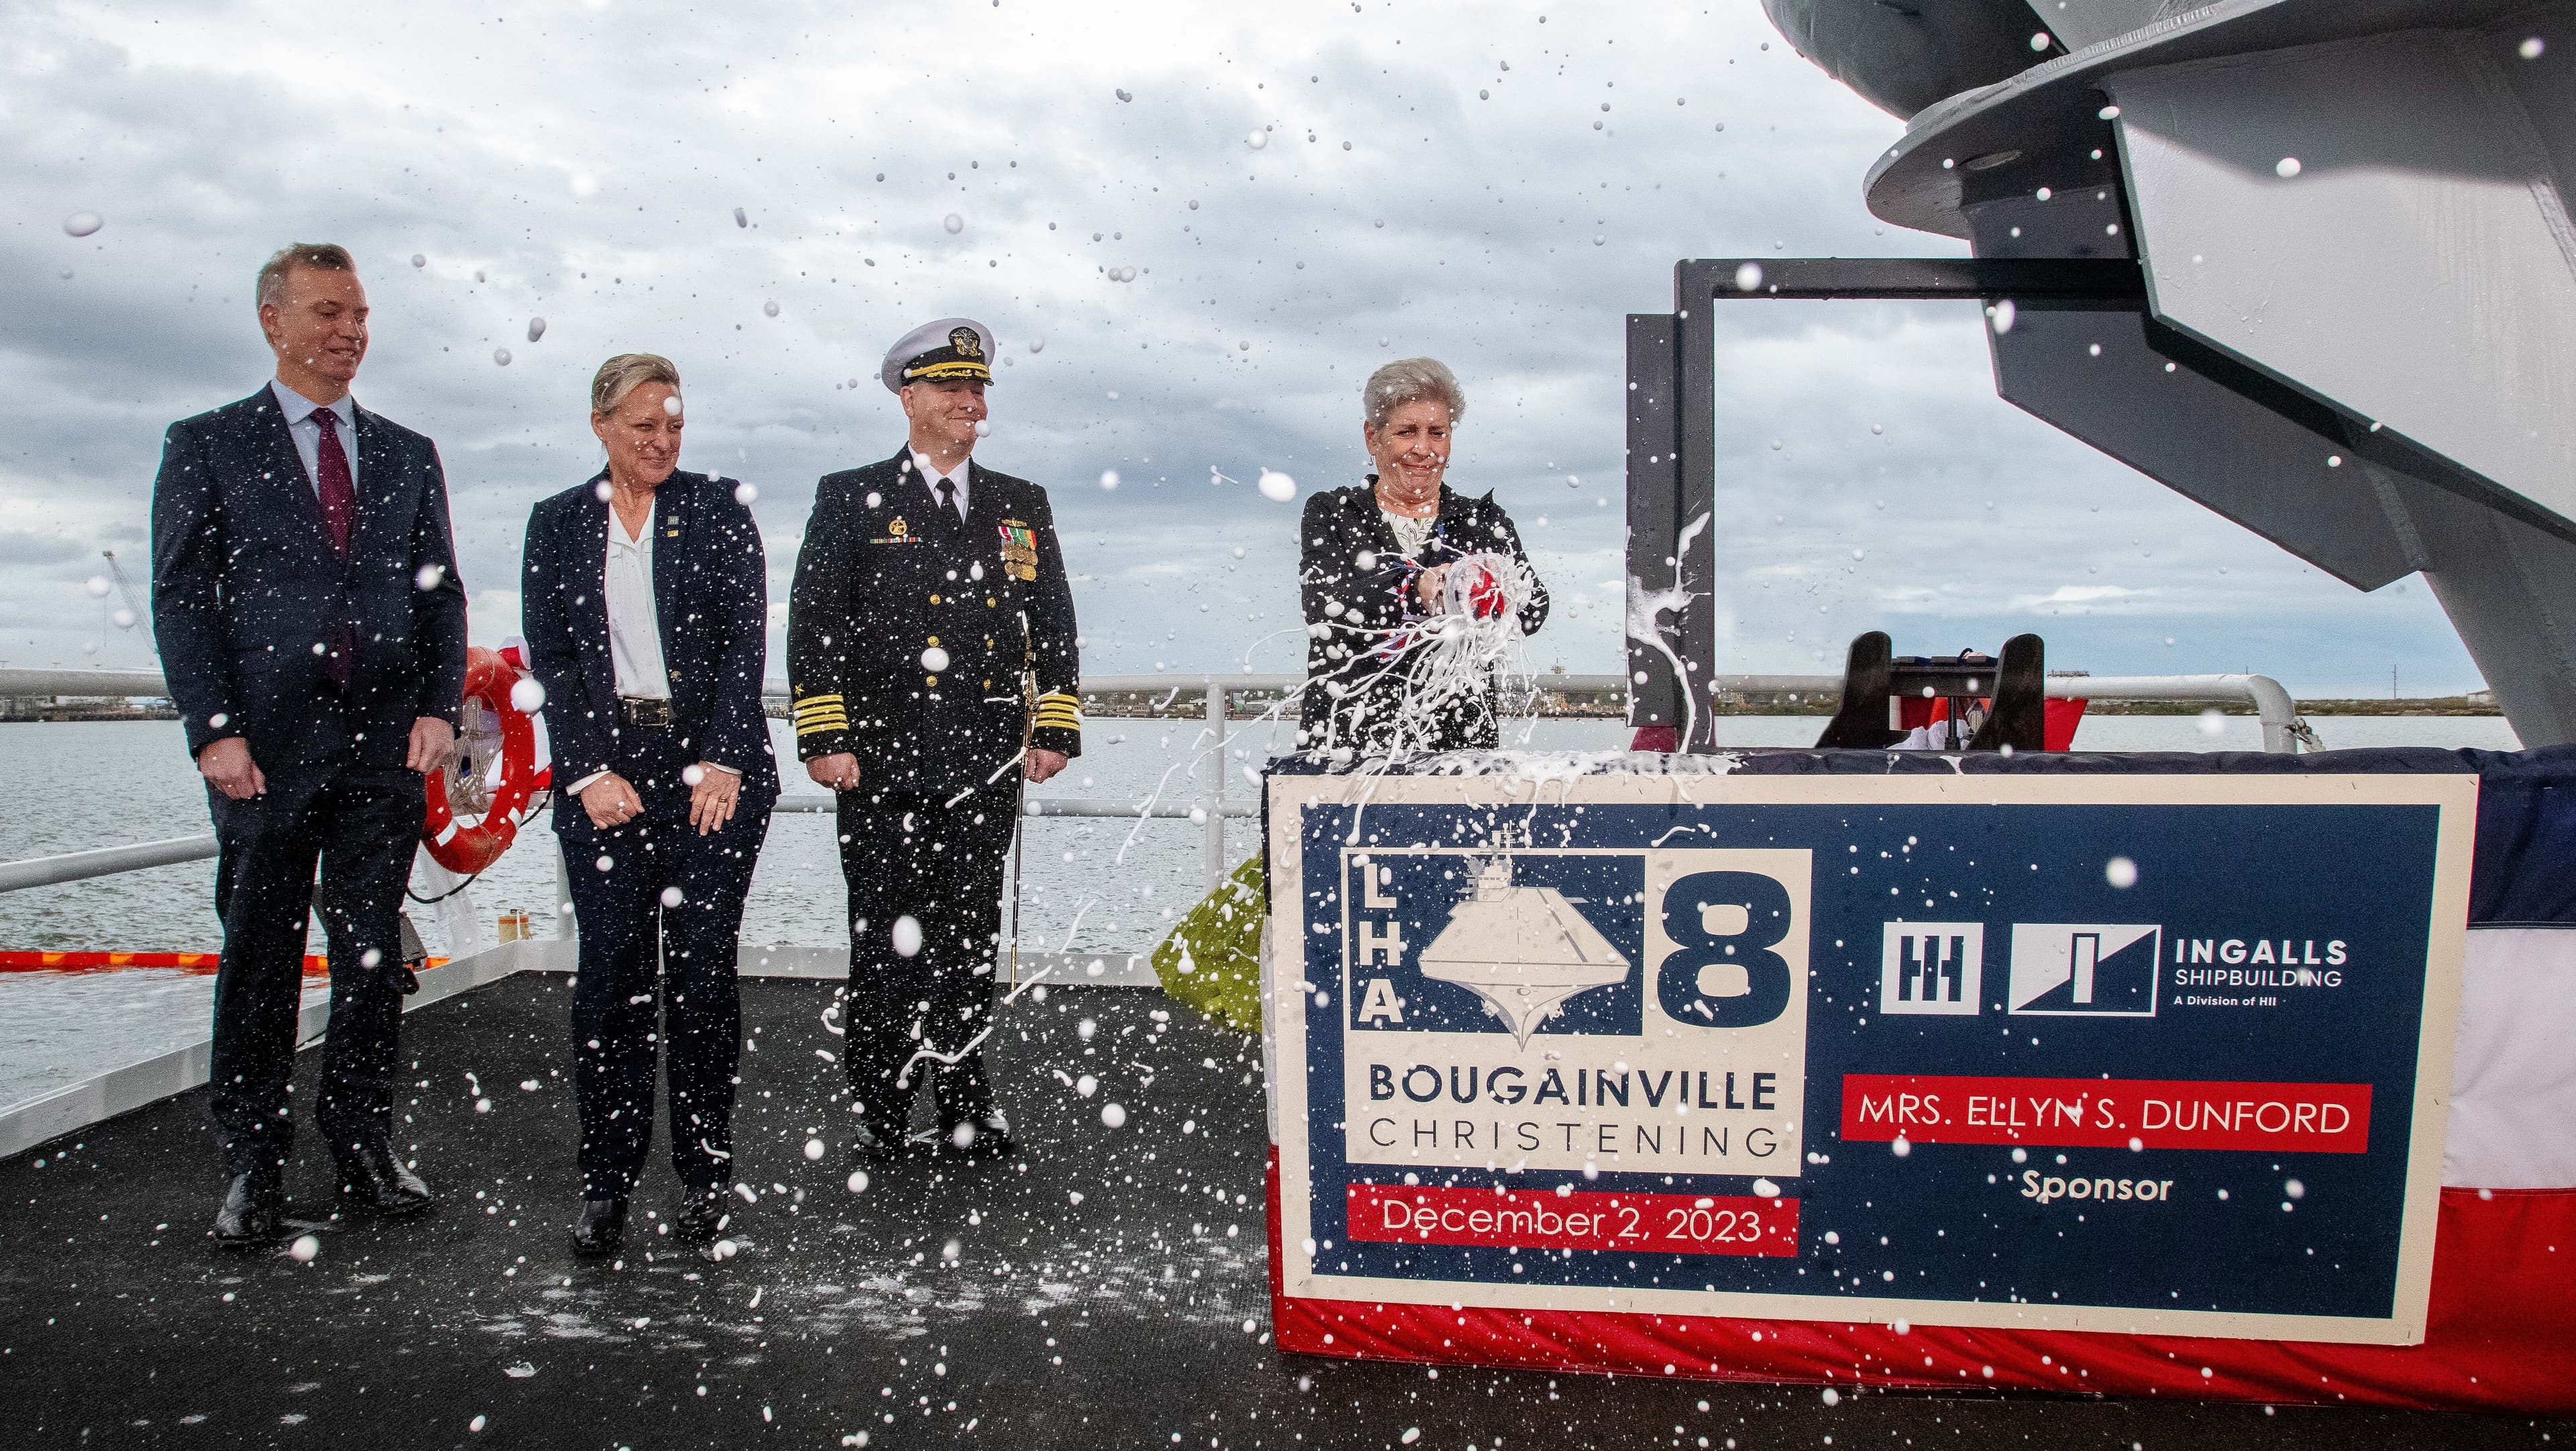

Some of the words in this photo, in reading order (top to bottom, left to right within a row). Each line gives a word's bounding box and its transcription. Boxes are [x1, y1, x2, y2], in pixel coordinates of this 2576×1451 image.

[1358, 863, 1403, 1023] LHA
[1657, 871, 1792, 1028] 8
[2176, 939, 2347, 965] INGALLS
[2175, 969, 2342, 987] SHIPBUILDING
[2174, 996, 2183, 1005] A
[2187, 996, 2239, 1006] Division
[2242, 996, 2256, 1006] of
[2259, 997, 2277, 1006] HII
[1370, 1063, 1776, 1110] BOUGAINVILLE
[1859, 1093, 1951, 1125] MRS.
[1968, 1095, 2082, 1128] ELLYN
[2095, 1098, 2126, 1129] S.
[2142, 1099, 2351, 1134] DUNFORD
[1370, 1117, 1778, 1157] CHRISTENING
[2021, 1170, 2174, 1204] Sponsor
[1383, 1199, 1606, 1236] December
[1617, 1207, 1648, 1241] 2,
[1666, 1208, 1762, 1242] 2023
